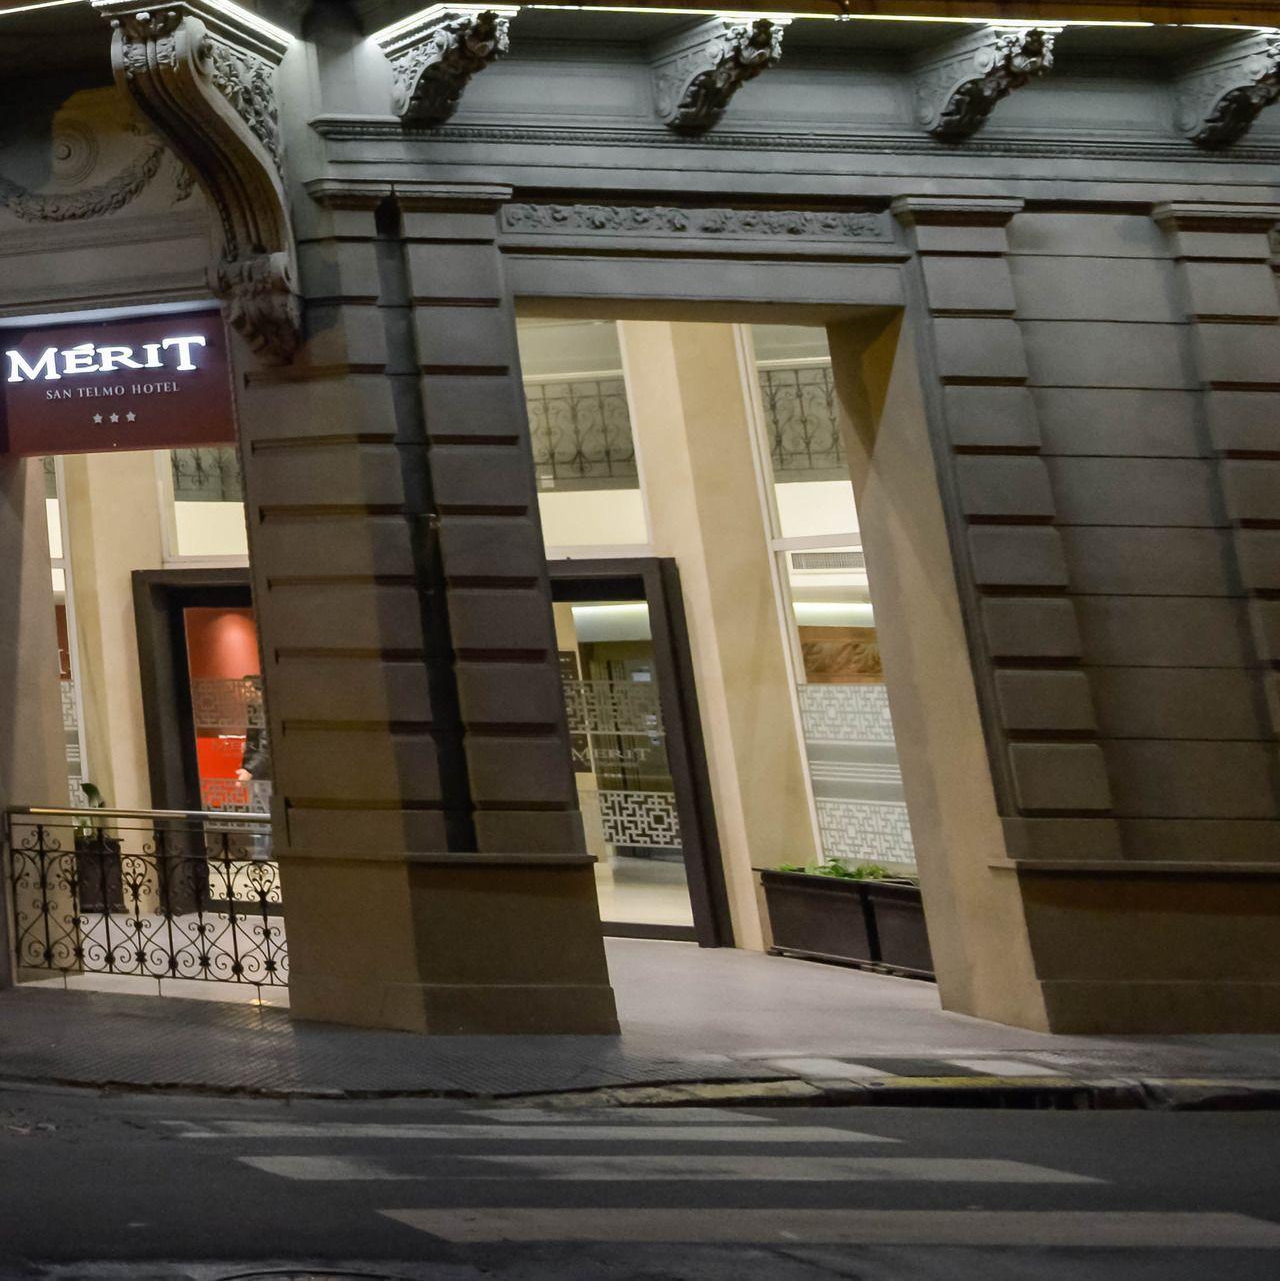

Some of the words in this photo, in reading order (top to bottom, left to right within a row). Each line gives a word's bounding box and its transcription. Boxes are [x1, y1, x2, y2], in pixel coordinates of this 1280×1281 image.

[5, 336, 206, 382] MÉRIT
[46, 388, 72, 400] SAN
[77, 385, 125, 398] TELMO
[132, 381, 180, 395] HOTEL
